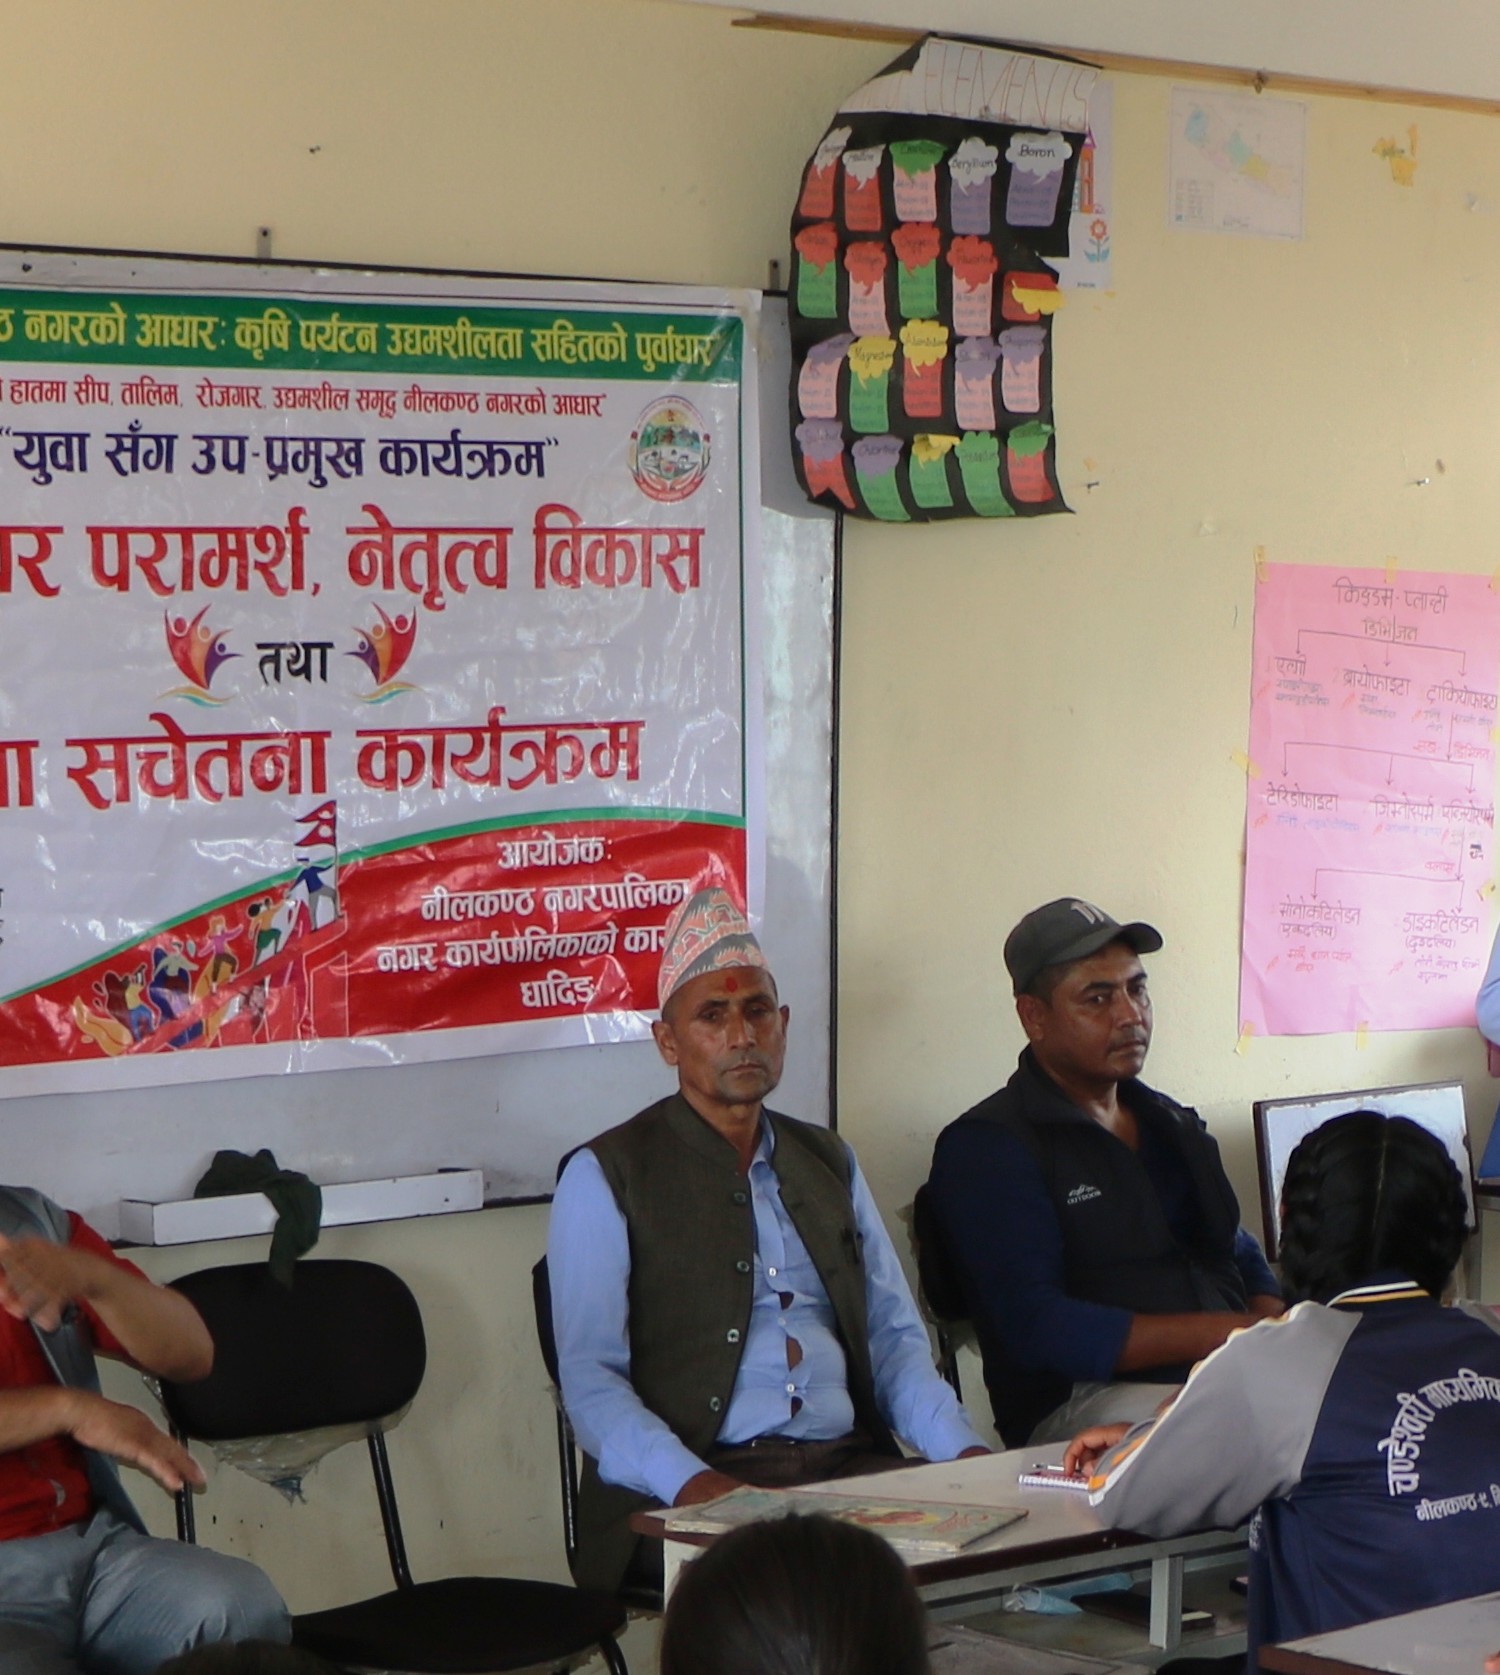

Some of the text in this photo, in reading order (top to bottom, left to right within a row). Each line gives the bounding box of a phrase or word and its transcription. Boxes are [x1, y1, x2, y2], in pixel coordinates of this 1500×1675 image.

[1019, 144, 1056, 159] Boron
[23, 302, 128, 348] नगरको
[234, 307, 291, 359] कृषि
[300, 312, 378, 354] पर्यटन
[385, 316, 524, 360] उद्यमशीलता
[530, 321, 628, 364] सहितको
[9, 377, 67, 404] हातमा
[273, 383, 351, 413] उद्यमशील
[356, 388, 396, 419] समृद्ध
[403, 383, 480, 414] नीलकण्ठ
[486, 387, 548, 416] नगरको
[105, 418, 178, 477] सँग
[191, 430, 365, 488] उप-प्रमुख
[378, 428, 560, 481] कार्यक्रम”
[88, 506, 322, 603] परामर्श,
[345, 504, 513, 612] नेतृत्व
[531, 506, 706, 596] विकास
[256, 639, 334, 686] तथा
[66, 712, 334, 810] सचेतना
[356, 707, 647, 795] कार्यक्रम
[420, 872, 691, 922] नीलकण्ठ नगरपालिका
[376, 941, 437, 973] नगर
[445, 922, 619, 967] कार्यपालिकाको
[1377, 1392, 1436, 1497] चण्डेश्वरी
